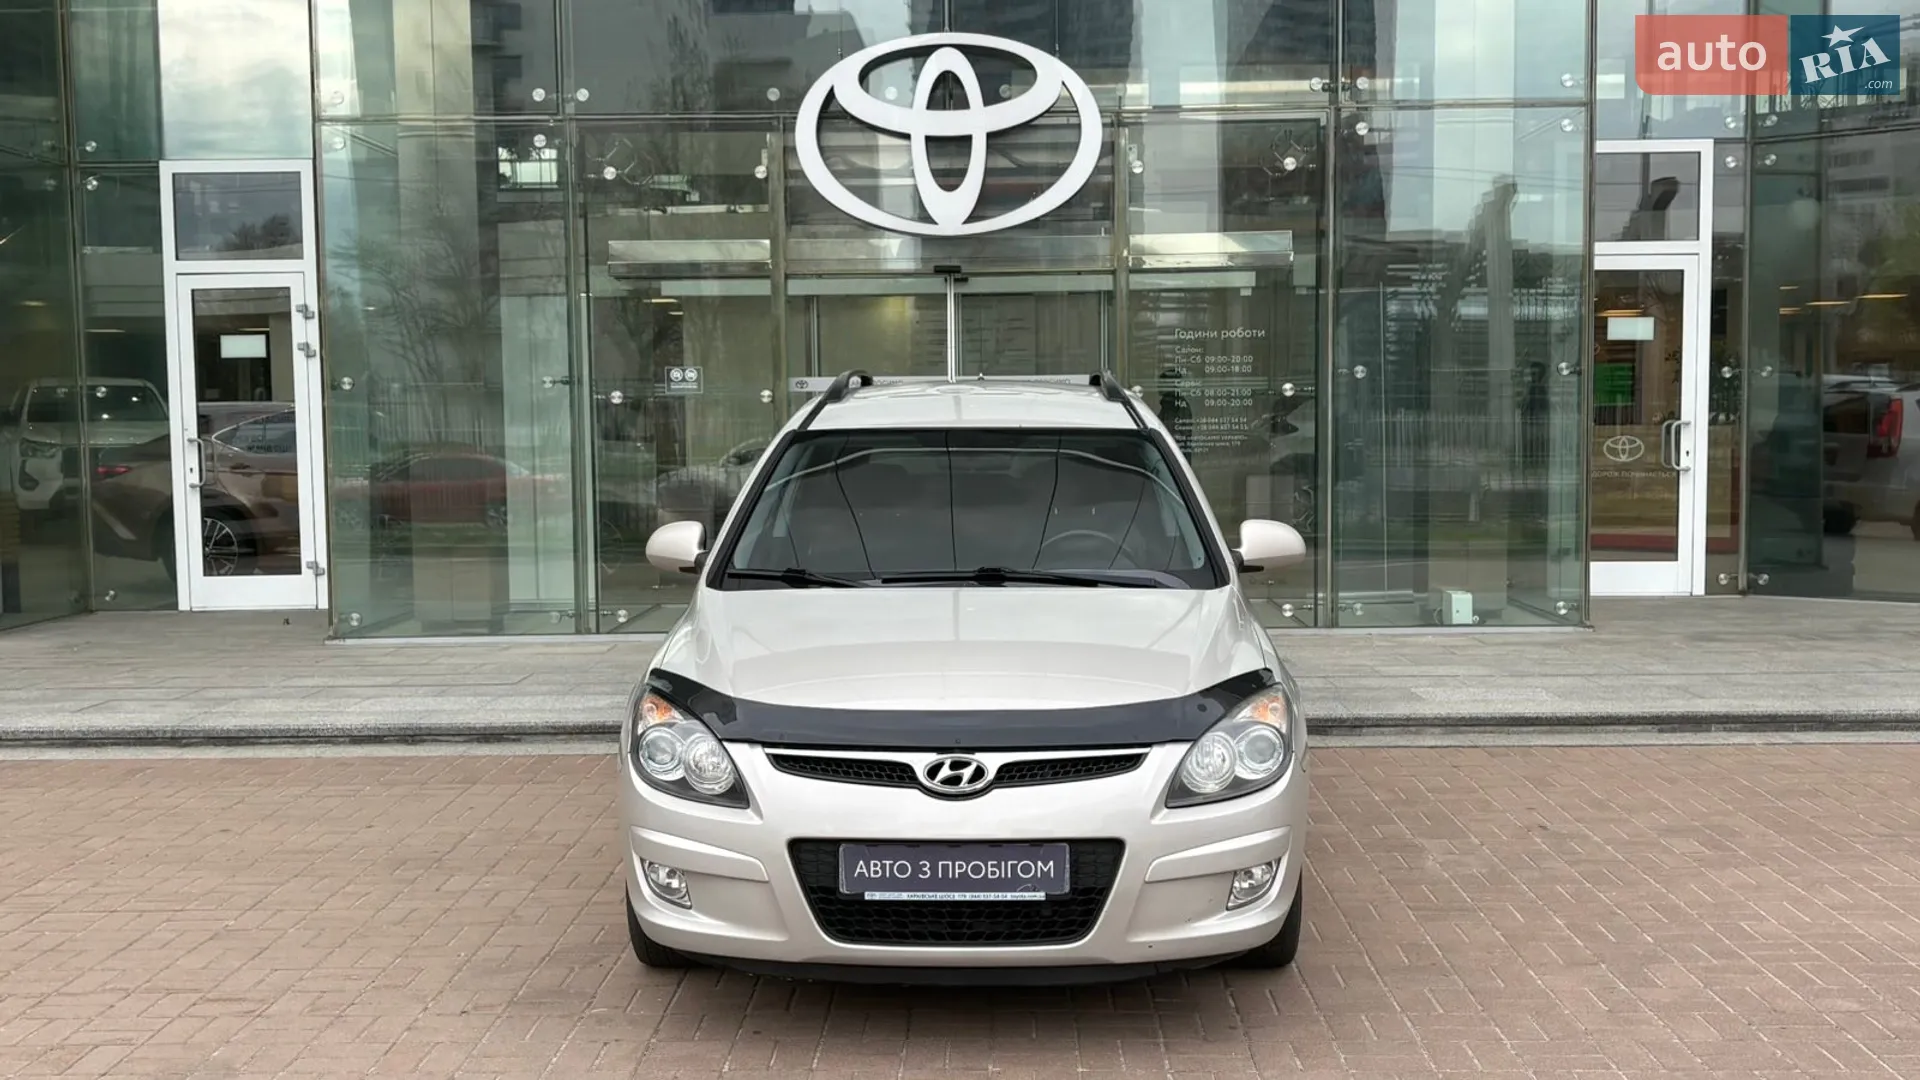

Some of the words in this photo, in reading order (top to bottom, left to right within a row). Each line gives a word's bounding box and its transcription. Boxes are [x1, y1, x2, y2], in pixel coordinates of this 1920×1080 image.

[1174, 328, 1218, 340] Години
[1221, 327, 1265, 340] роботи
[854, 860, 912, 878] АВТО
[938, 860, 1054, 878] ПРОБІГОМ
